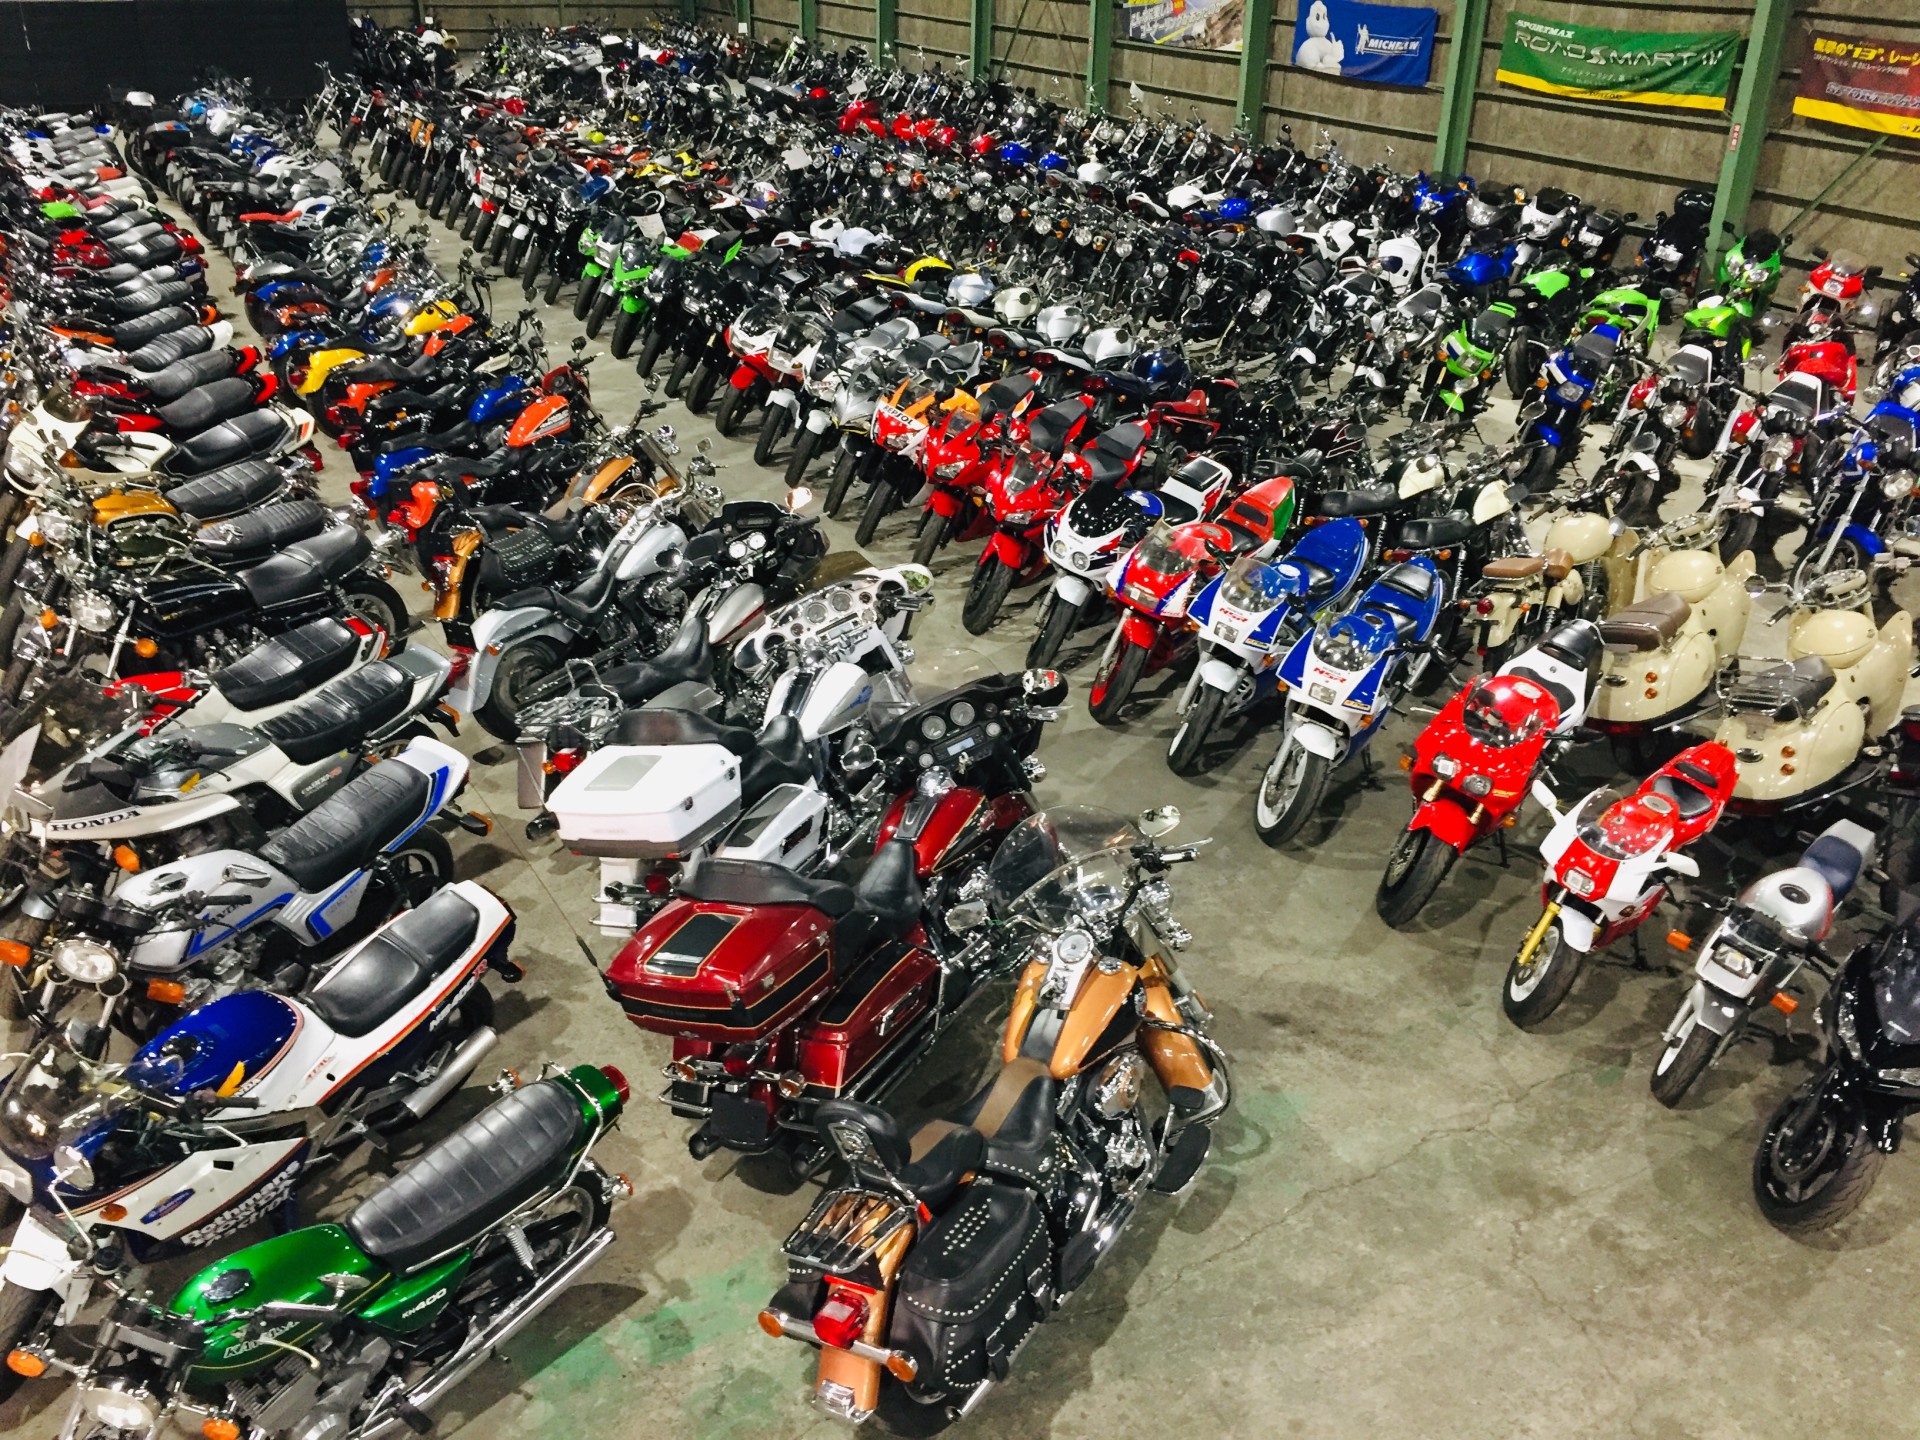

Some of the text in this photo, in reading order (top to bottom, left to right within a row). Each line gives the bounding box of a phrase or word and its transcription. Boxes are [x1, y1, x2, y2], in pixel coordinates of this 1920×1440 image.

[1515, 19, 1575, 39] SPORTMAX
[1368, 38, 1420, 50] MICHELIN
[883, 404, 914, 425] REPSOL
[51, 809, 141, 832] HONDA
[180, 1160, 300, 1246] Rothmans
[193, 1178, 296, 1247] HONDA
